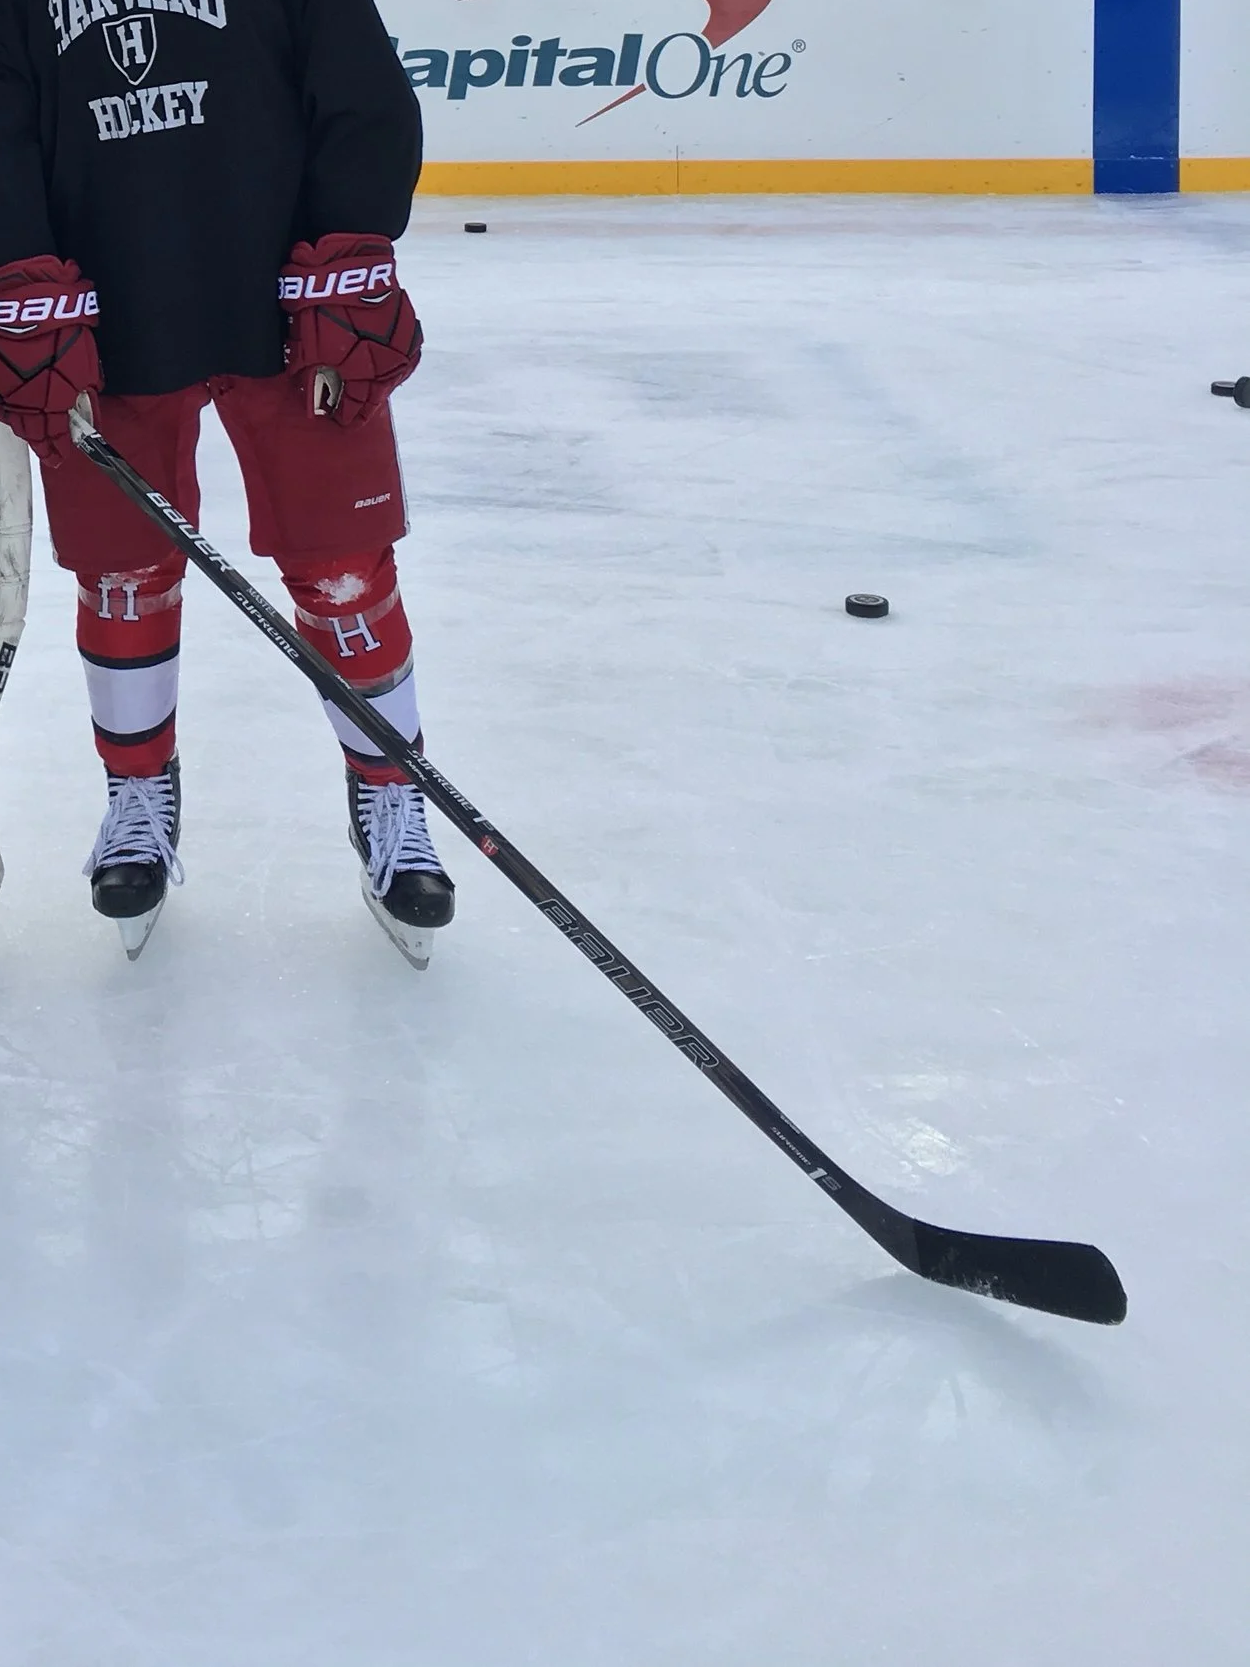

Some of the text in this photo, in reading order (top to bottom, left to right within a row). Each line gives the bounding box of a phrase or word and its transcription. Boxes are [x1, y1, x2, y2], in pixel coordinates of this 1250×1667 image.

[116, 21, 147, 69] H
[88, 81, 209, 142] HOCKEY
[328, 612, 382, 658] H
